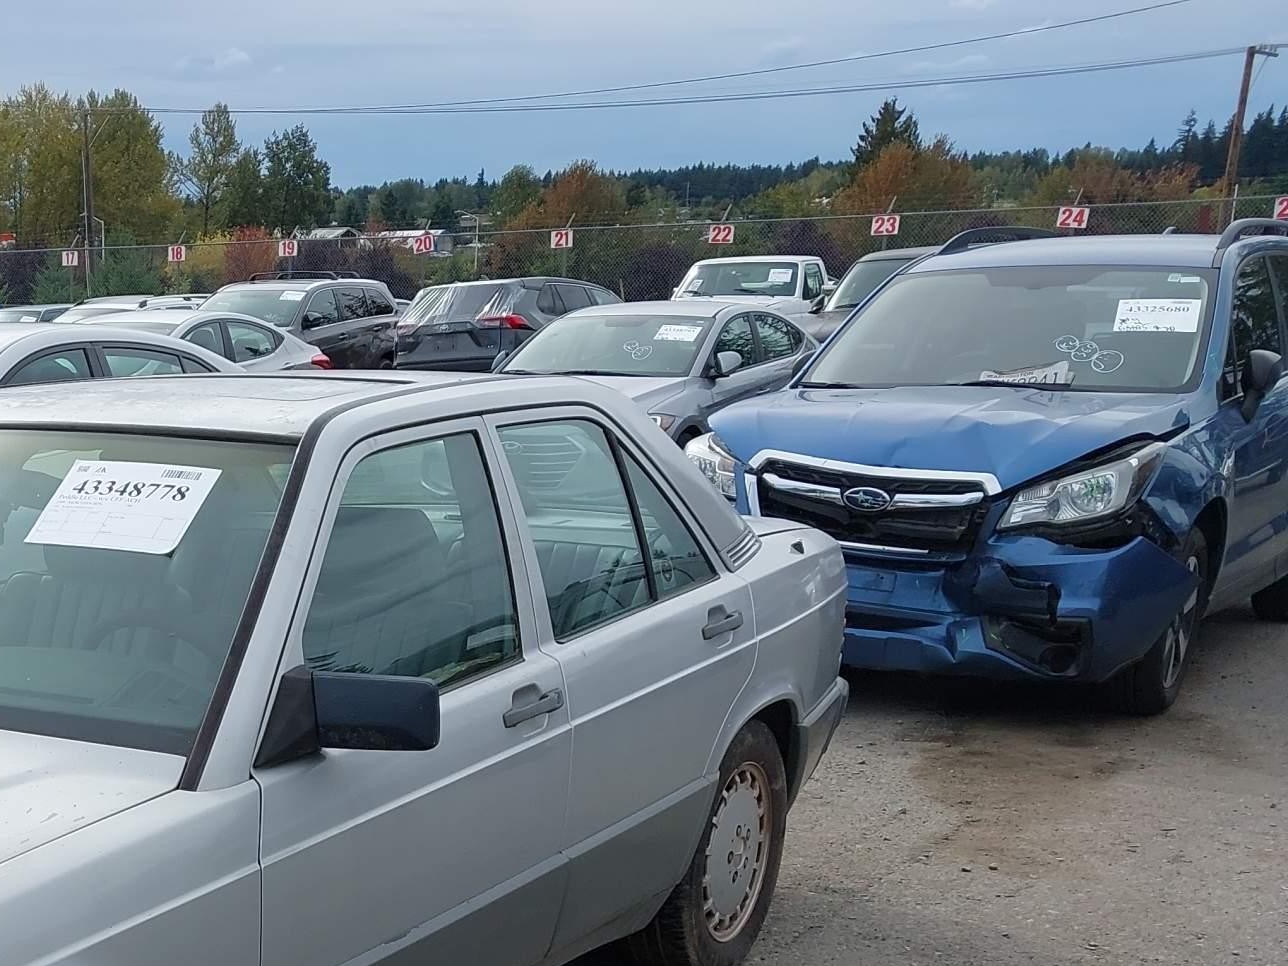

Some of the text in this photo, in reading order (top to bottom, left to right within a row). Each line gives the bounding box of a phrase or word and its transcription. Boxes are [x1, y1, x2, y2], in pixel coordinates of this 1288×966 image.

[873, 214, 898, 235] 23
[1058, 206, 1086, 228] 24
[414, 233, 433, 253] 20
[554, 230, 569, 248] 21
[711, 225, 732, 245] 22
[65, 251, 76, 265] 17
[170, 245, 183, 261] 18
[281, 240, 295, 256] 19
[72, 479, 191, 502] 43348778
